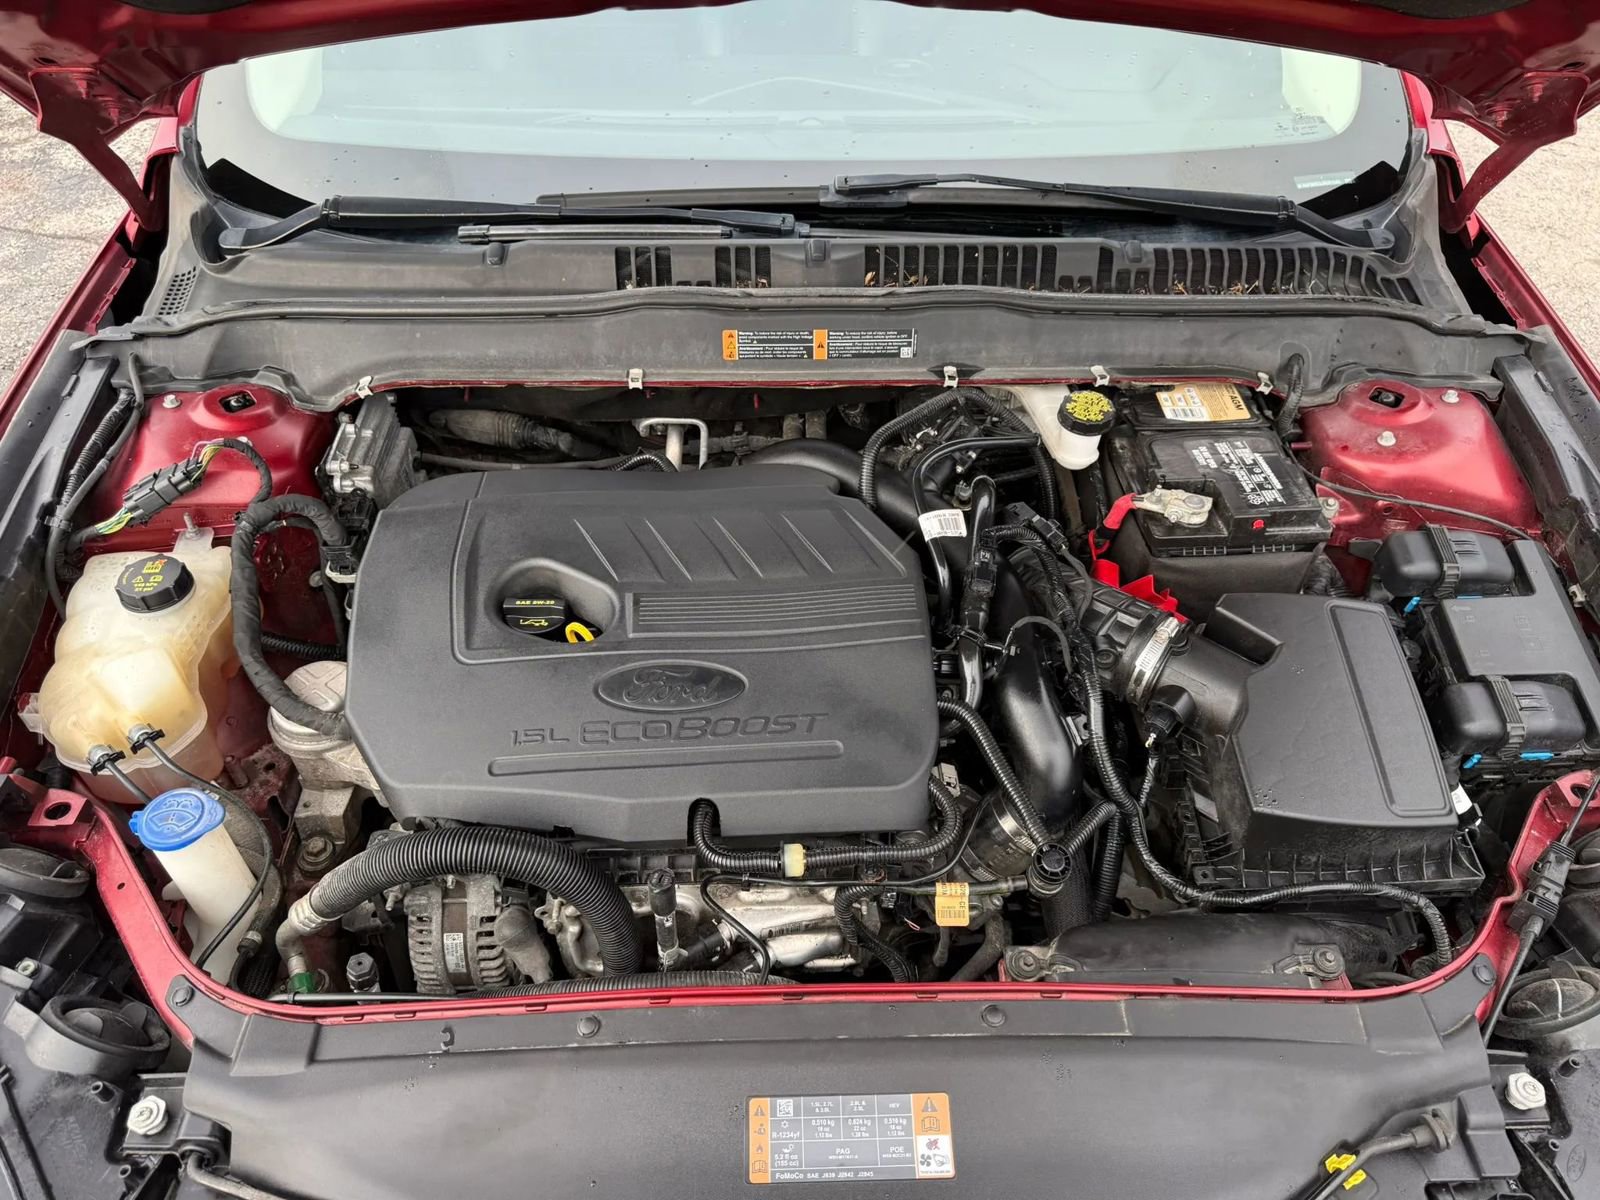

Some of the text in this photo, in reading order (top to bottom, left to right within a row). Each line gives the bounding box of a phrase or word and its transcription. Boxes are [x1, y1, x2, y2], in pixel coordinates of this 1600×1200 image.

[1230, 395, 1243, 410] AGM
[622, 668, 722, 704] Ford
[510, 728, 570, 747] 1.5L
[772, 1132, 800, 1140] R-1234yf
[776, 1172, 804, 1180] FoMoCo
